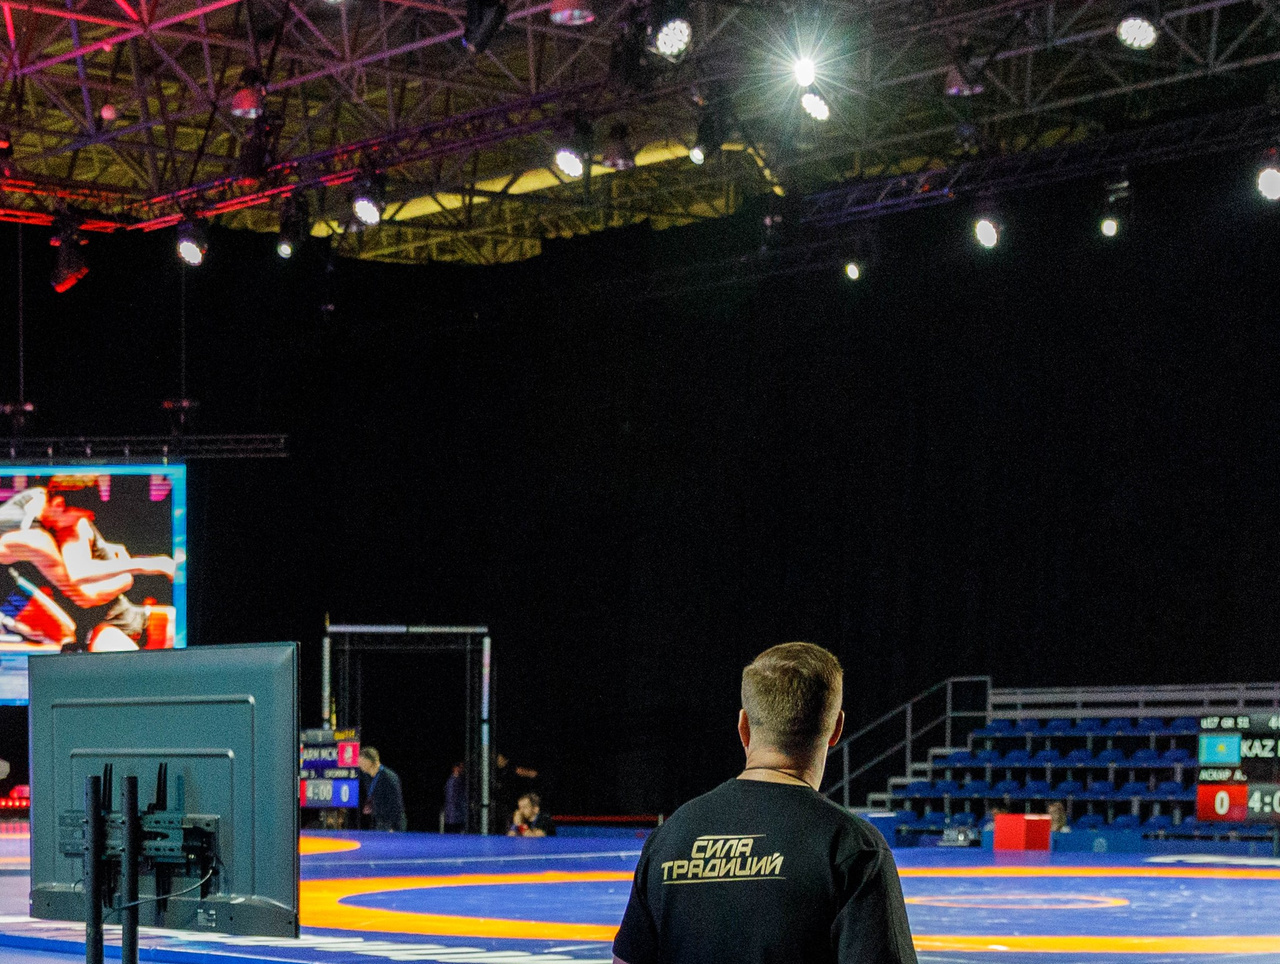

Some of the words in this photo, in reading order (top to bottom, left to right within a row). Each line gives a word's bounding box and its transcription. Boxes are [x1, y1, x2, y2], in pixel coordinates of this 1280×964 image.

[1241, 738, 1275, 758] KAZ
[341, 785, 350, 803] 0
[1214, 790, 1229, 815] 0
[691, 838, 754, 859] СИЛА
[661, 852, 784, 881] ТРАДИЦИЙ
